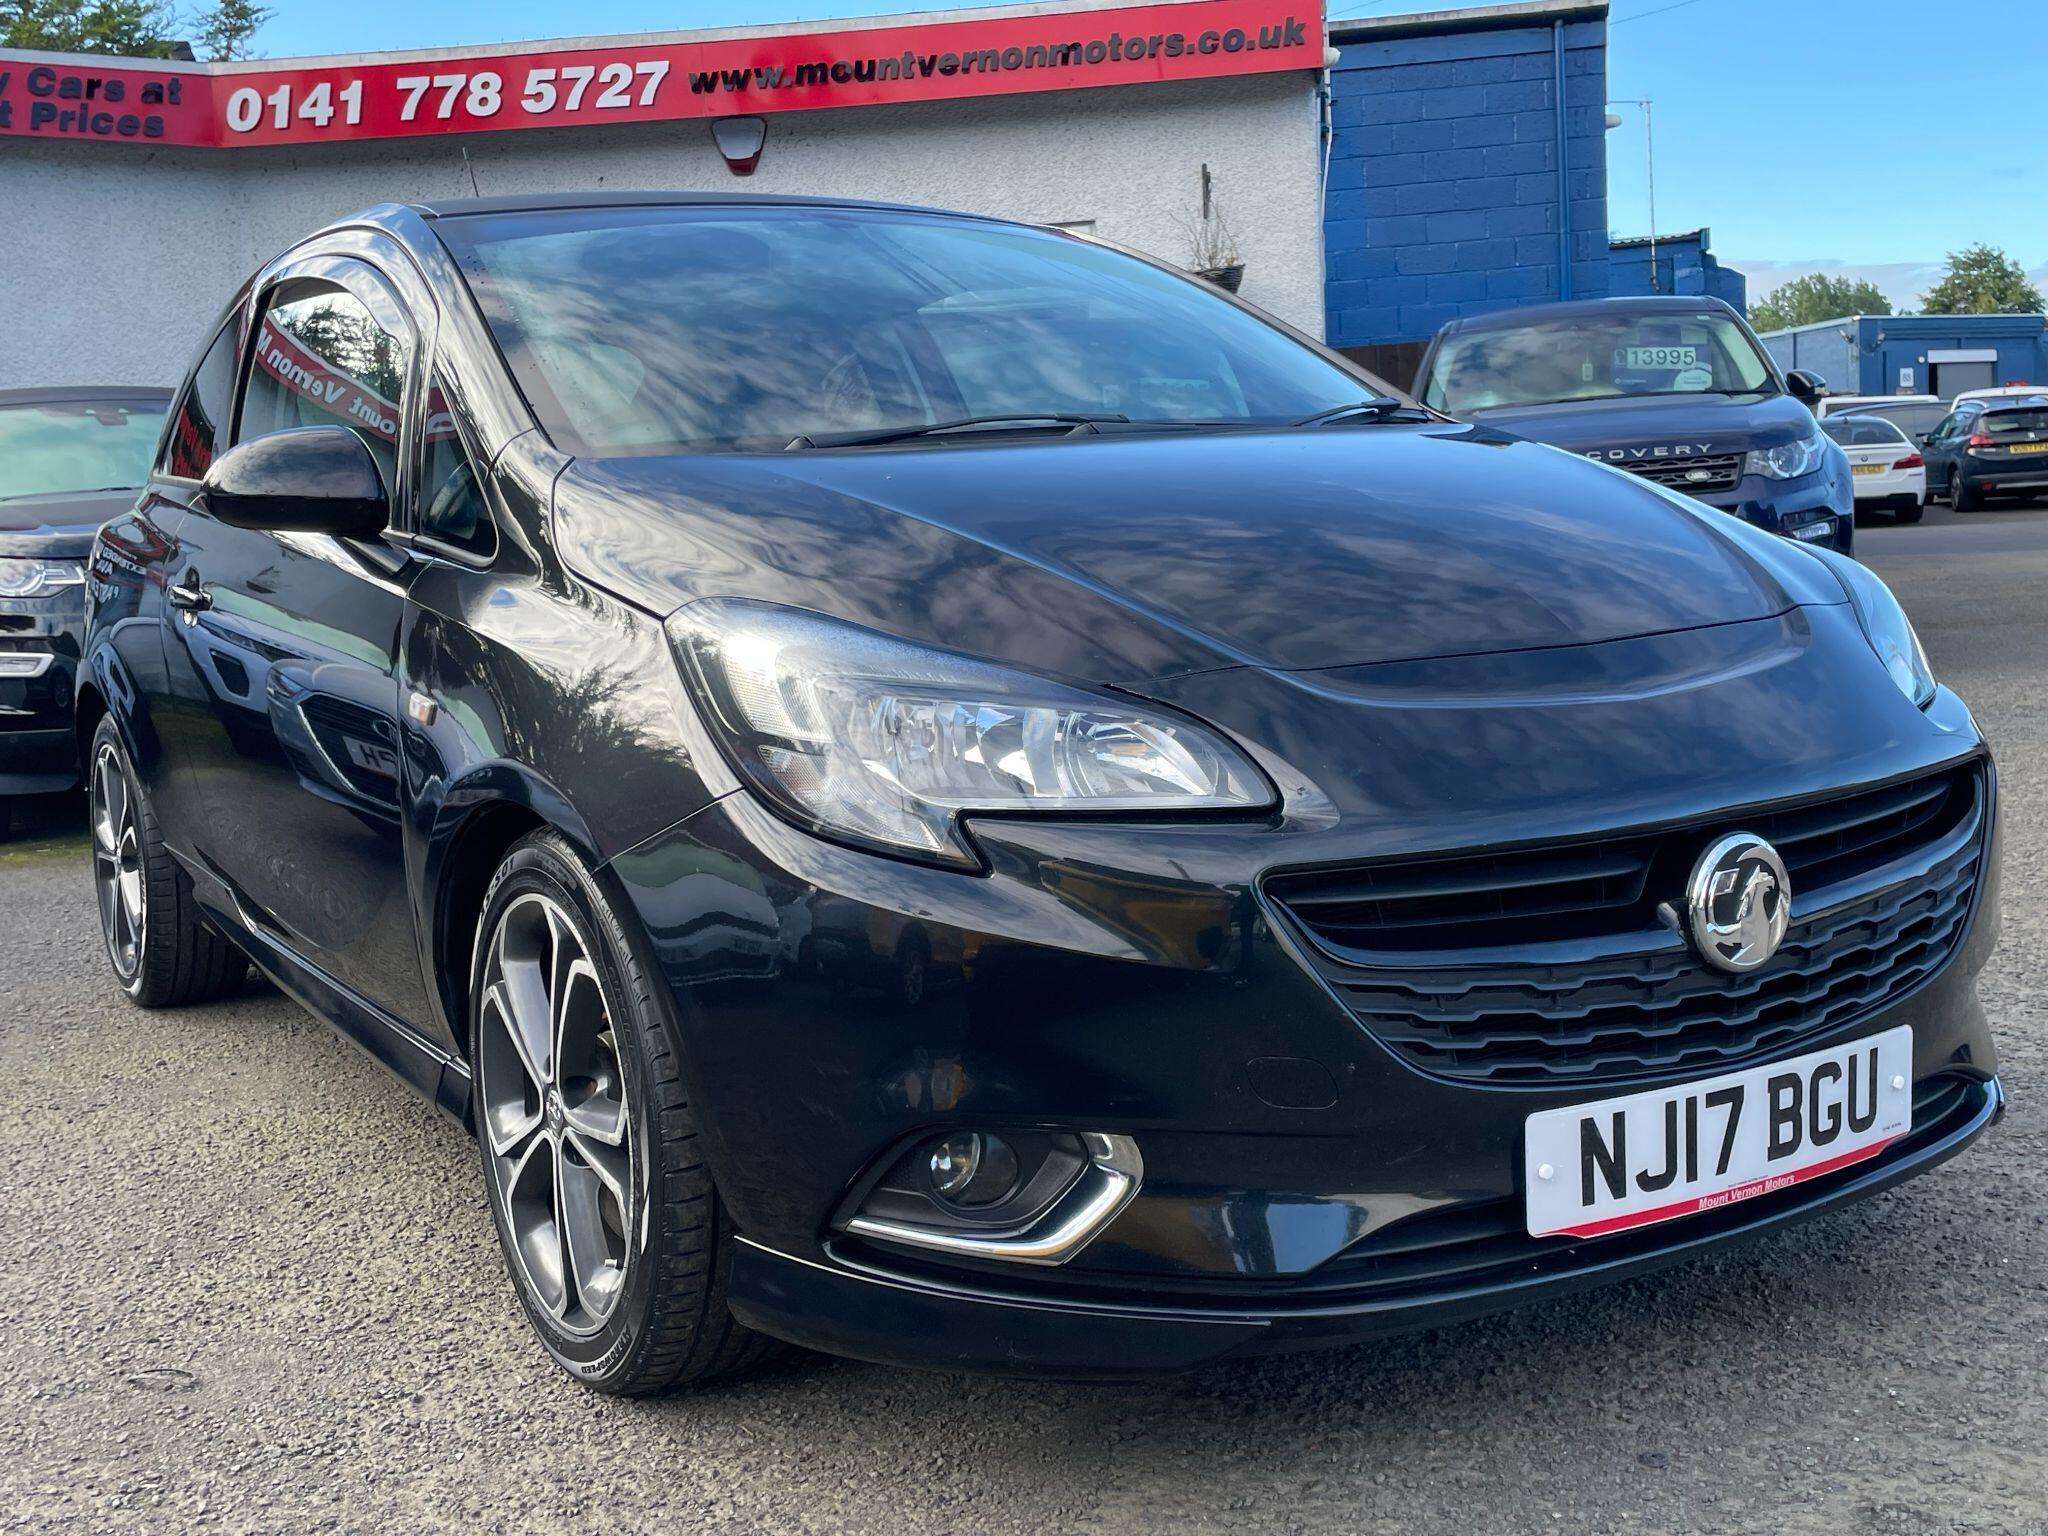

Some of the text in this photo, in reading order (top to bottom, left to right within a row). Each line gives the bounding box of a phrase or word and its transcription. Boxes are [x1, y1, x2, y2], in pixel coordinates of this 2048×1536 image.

[688, 15, 1306, 95] www.mountvernonmotors.co.uk
[27, 67, 126, 102] Cars
[141, 77, 183, 105] at
[226, 60, 670, 133] 0141 778 5727
[30, 101, 165, 138] Prices
[1585, 443, 1713, 461] COVERY
[1579, 1046, 1879, 1207] NJ17 BGU
[1698, 1192, 1730, 1210] Mount
[1730, 1184, 1764, 1200] Vernon
[1764, 1174, 1796, 1191] Motors
